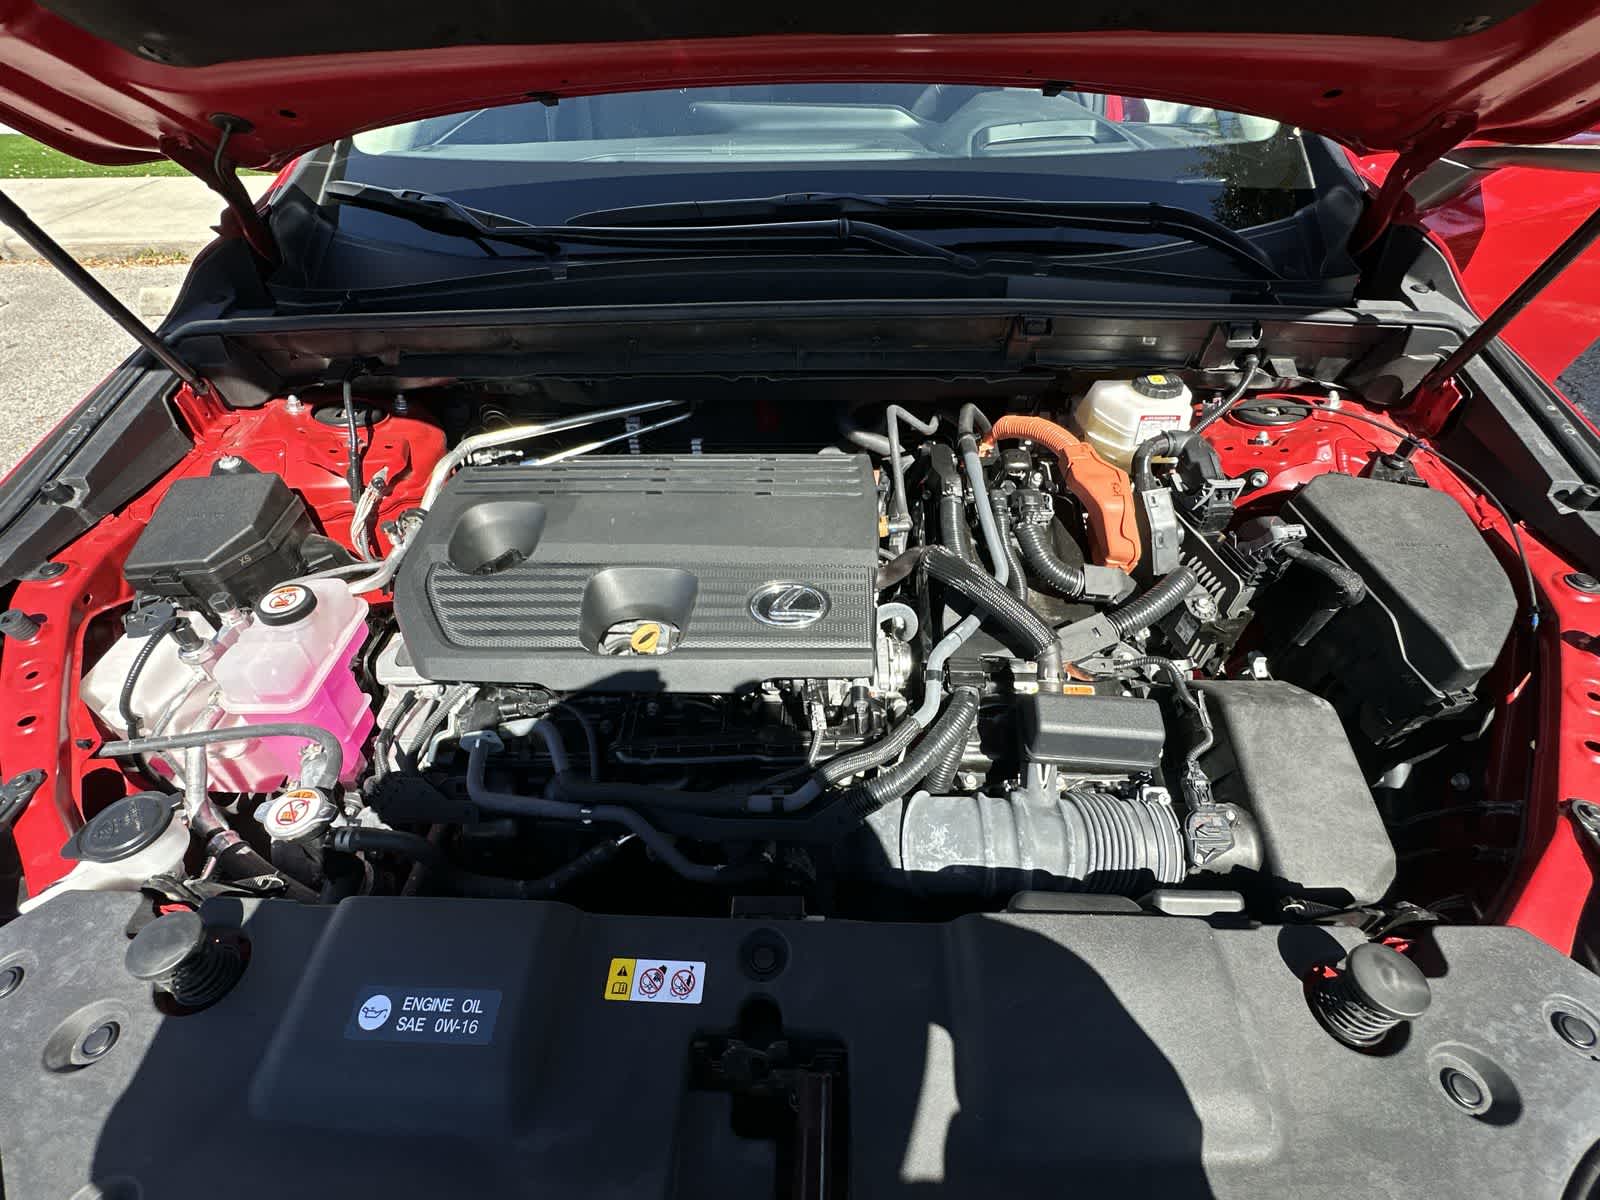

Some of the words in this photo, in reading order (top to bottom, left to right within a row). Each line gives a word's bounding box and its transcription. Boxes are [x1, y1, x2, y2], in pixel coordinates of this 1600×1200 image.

[401, 996, 455, 1012] ENGINE
[461, 999, 484, 1014] OIL
[396, 1016, 427, 1032] SAE
[434, 1018, 479, 1034] 0W-16
